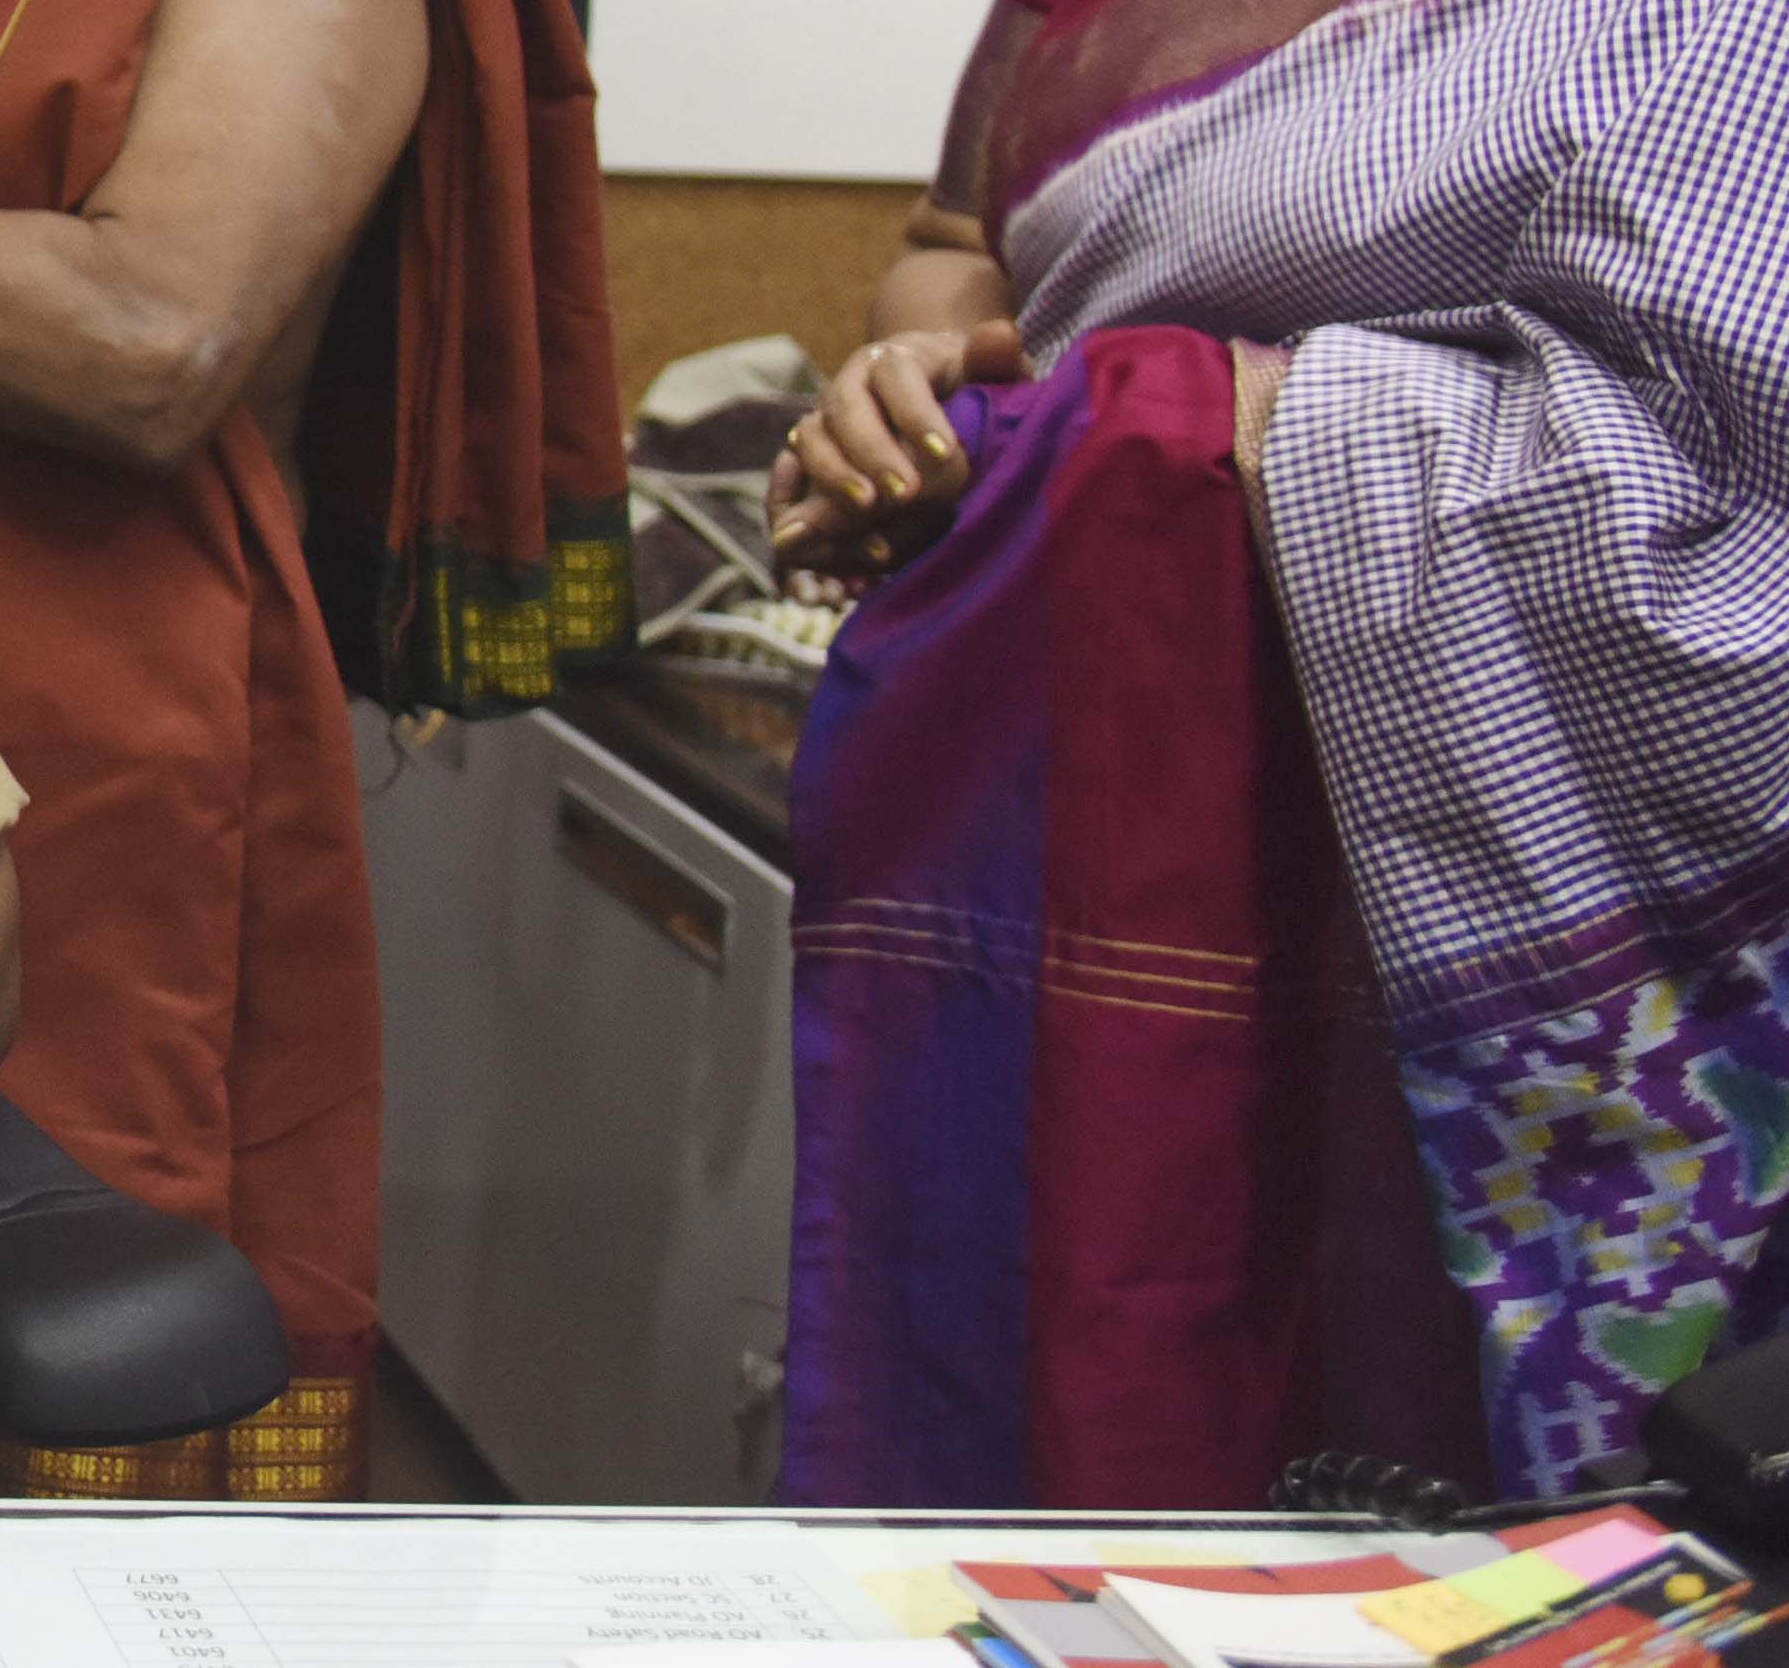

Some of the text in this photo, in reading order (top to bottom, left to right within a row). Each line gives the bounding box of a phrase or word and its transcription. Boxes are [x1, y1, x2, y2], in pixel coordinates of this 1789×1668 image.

[126, 1573, 179, 1584] 6677
[133, 1591, 189, 1602] 6406
[145, 1608, 201, 1620] 6431
[159, 1628, 213, 1639] 6417
[170, 1646, 225, 1658] 6401
